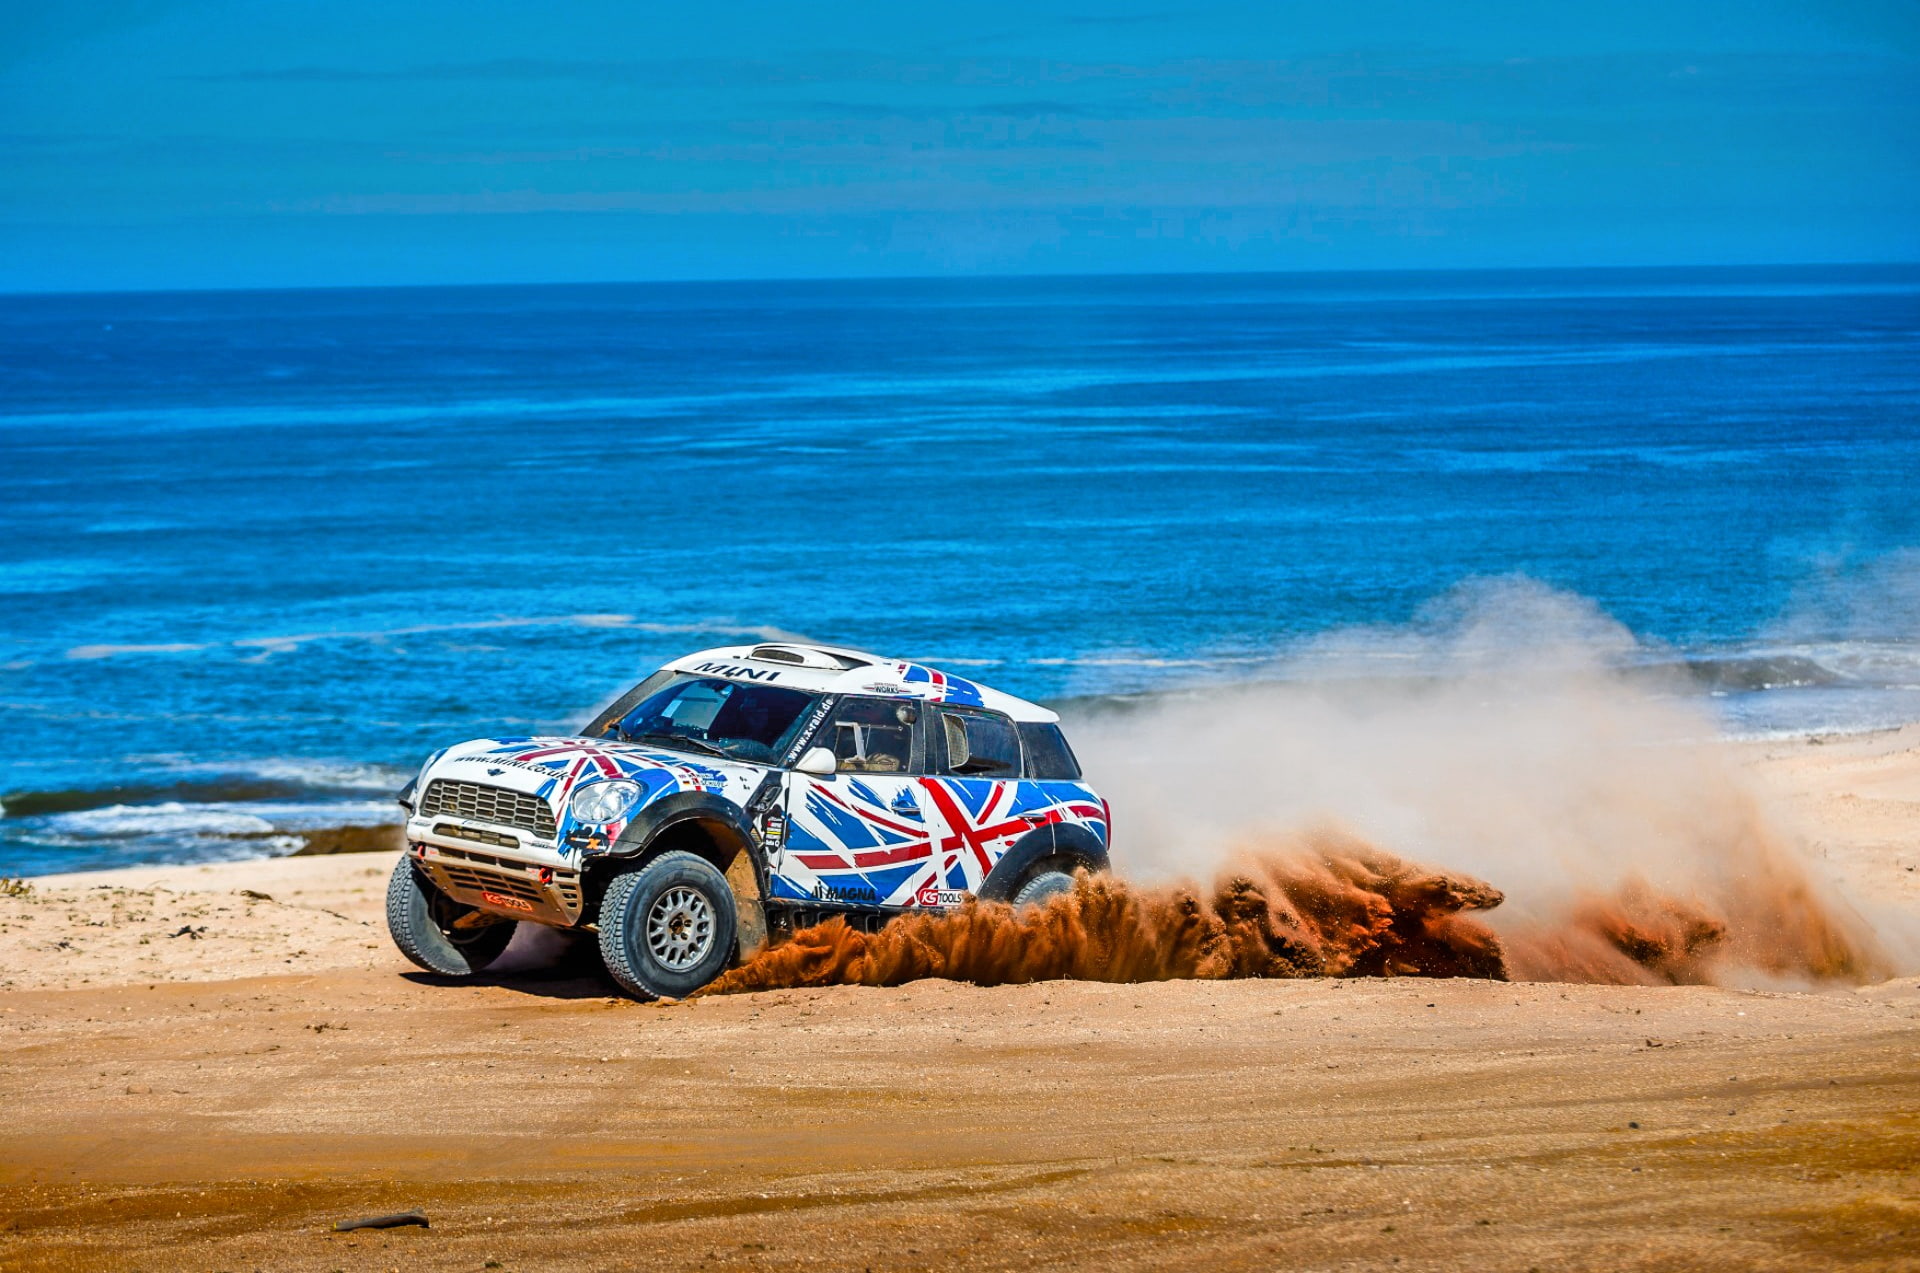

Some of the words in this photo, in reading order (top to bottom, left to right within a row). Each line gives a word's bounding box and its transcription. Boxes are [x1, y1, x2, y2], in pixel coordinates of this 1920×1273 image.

[694, 662, 782, 681] MINI
[875, 685, 900, 694] WORKS
[454, 757, 569, 781] www.MINI.co.uk
[826, 886, 877, 901] MAGNA
[921, 891, 937, 903] KS
[938, 892, 962, 903] TOOLS
